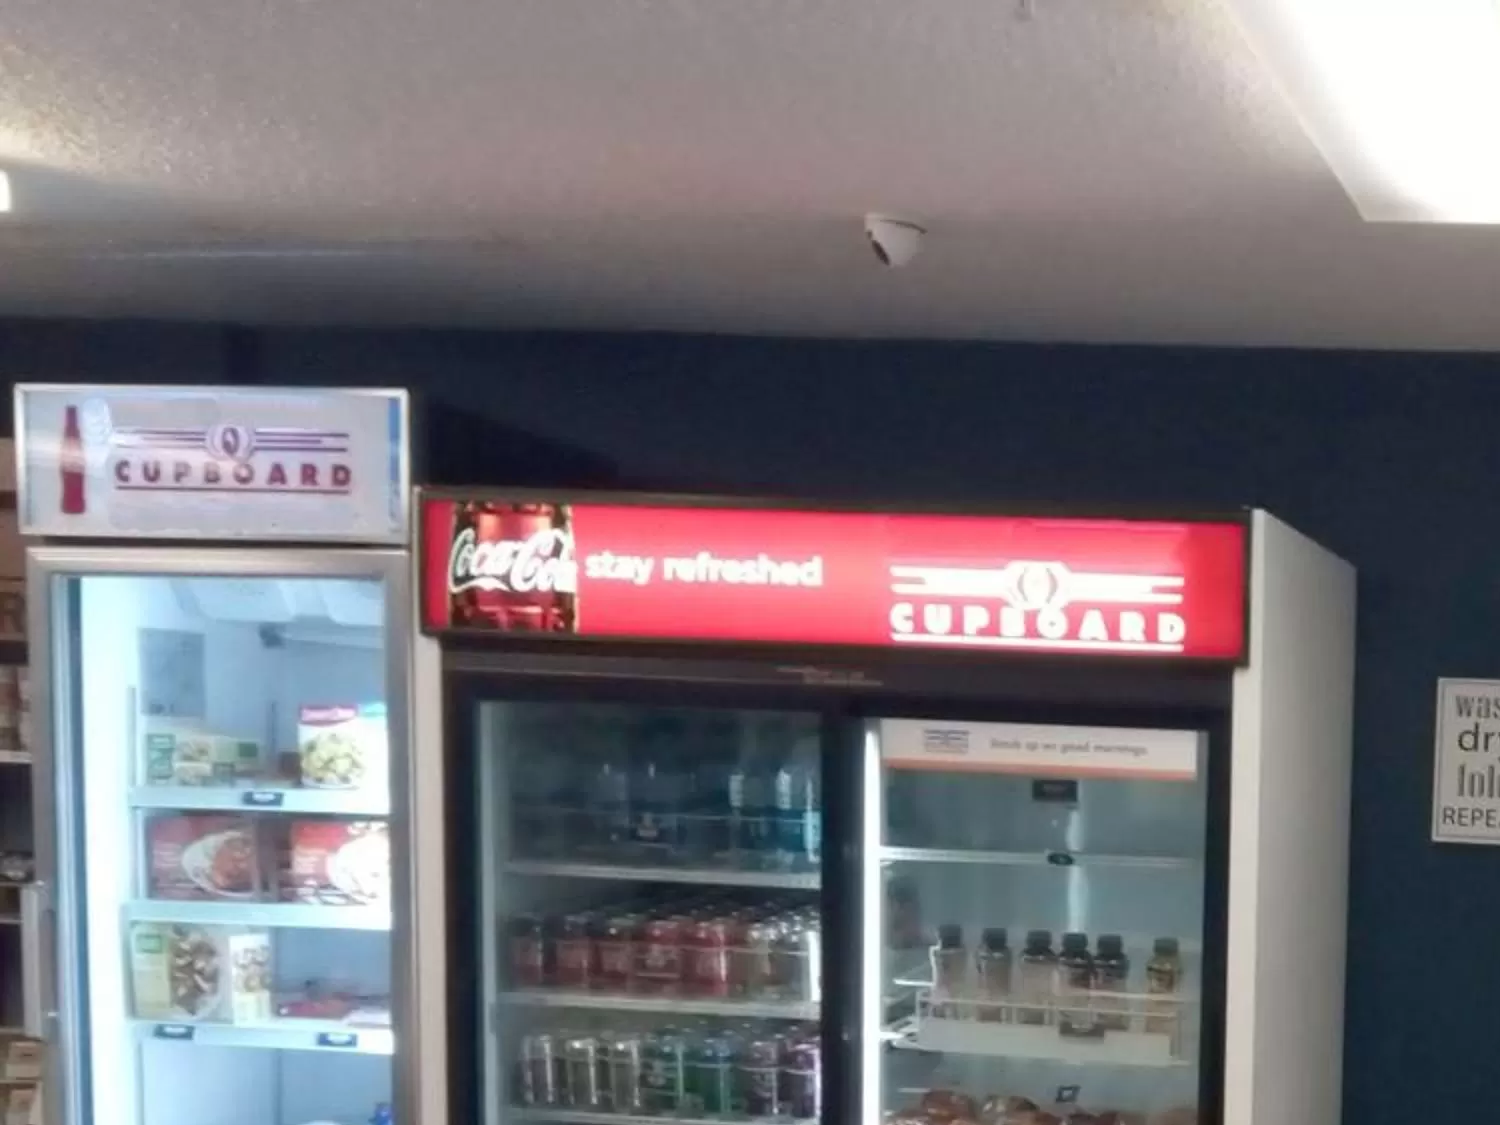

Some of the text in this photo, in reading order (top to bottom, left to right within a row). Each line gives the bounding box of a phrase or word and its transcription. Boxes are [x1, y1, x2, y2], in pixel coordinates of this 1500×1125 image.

[114, 459, 352, 487] CUPBOARD
[584, 550, 823, 587] stay refreshed
[889, 602, 1187, 643] CUPBOARD
